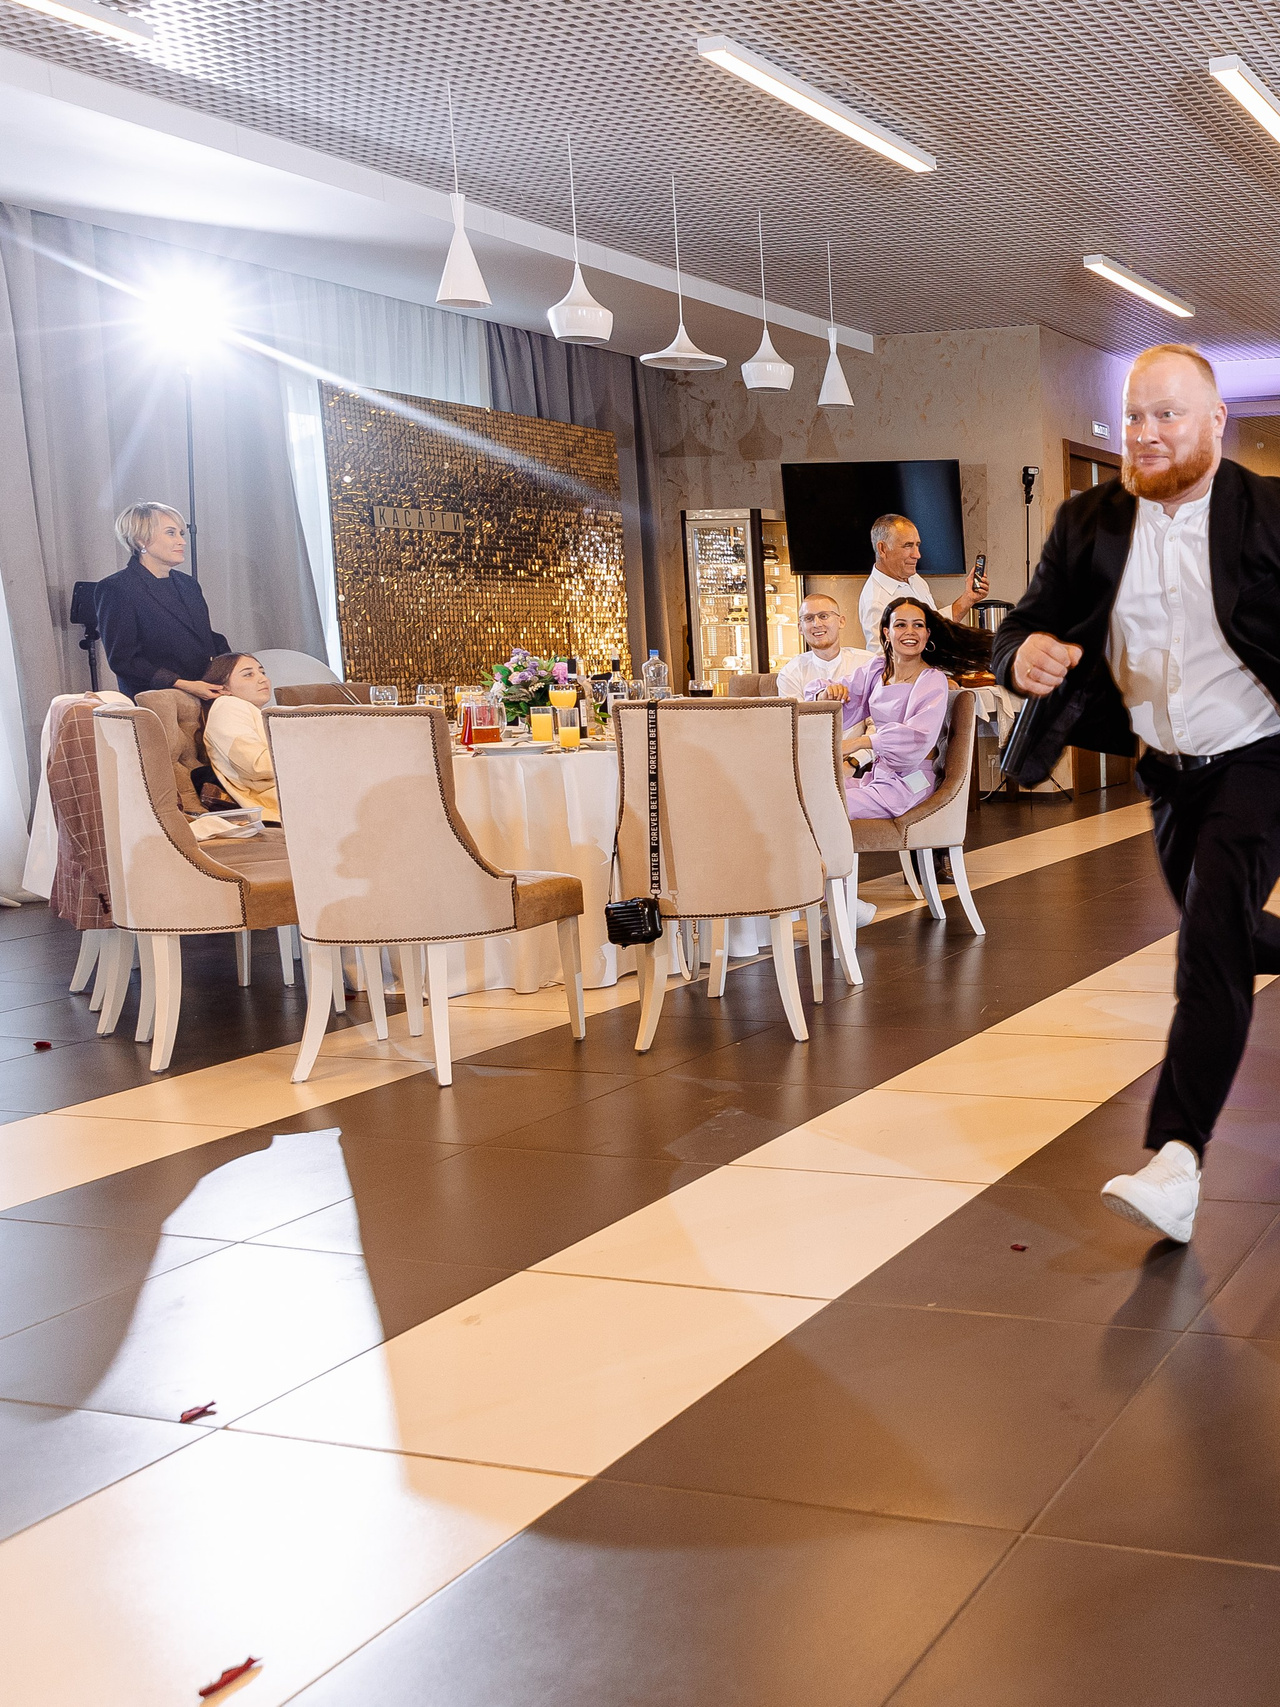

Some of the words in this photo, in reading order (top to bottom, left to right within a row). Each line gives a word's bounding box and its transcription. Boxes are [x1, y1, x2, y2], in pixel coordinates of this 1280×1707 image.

[378, 508, 461, 530] КАСАРГИ
[649, 709, 657, 738] BETTER
[649, 740, 657, 775] FOREVER
[649, 781, 658, 810] BETTER
[650, 812, 659, 846] FOREVER
[651, 852, 659, 881] BETTER
